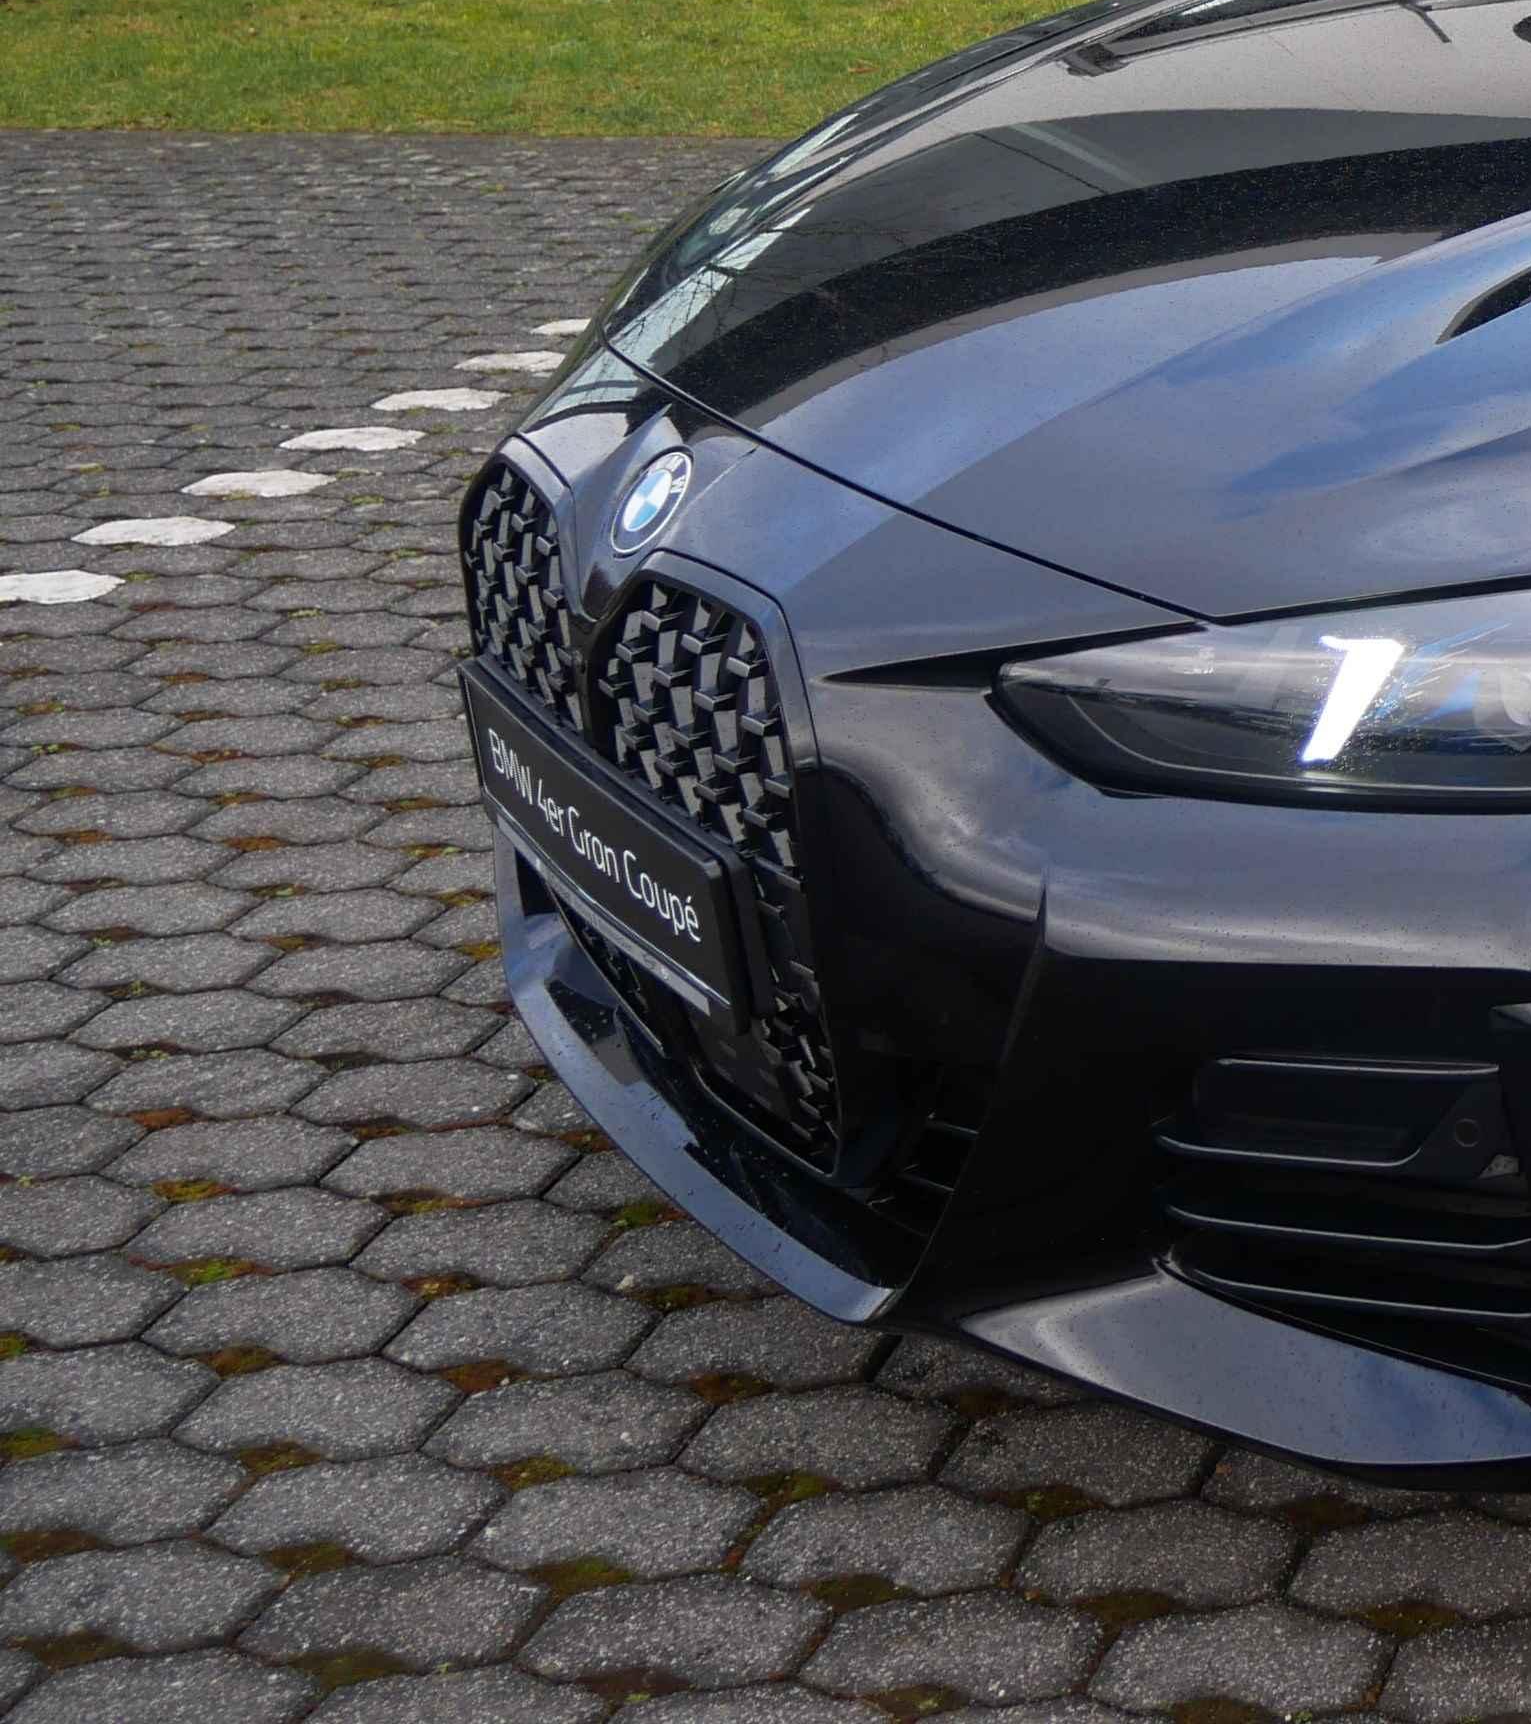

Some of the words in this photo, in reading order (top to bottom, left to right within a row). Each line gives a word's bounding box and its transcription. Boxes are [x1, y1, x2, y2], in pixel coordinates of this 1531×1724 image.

[488, 728, 533, 805] BMW
[537, 778, 564, 836] 4er
[568, 806, 620, 884] Gran
[623, 849, 702, 943] Coupé
